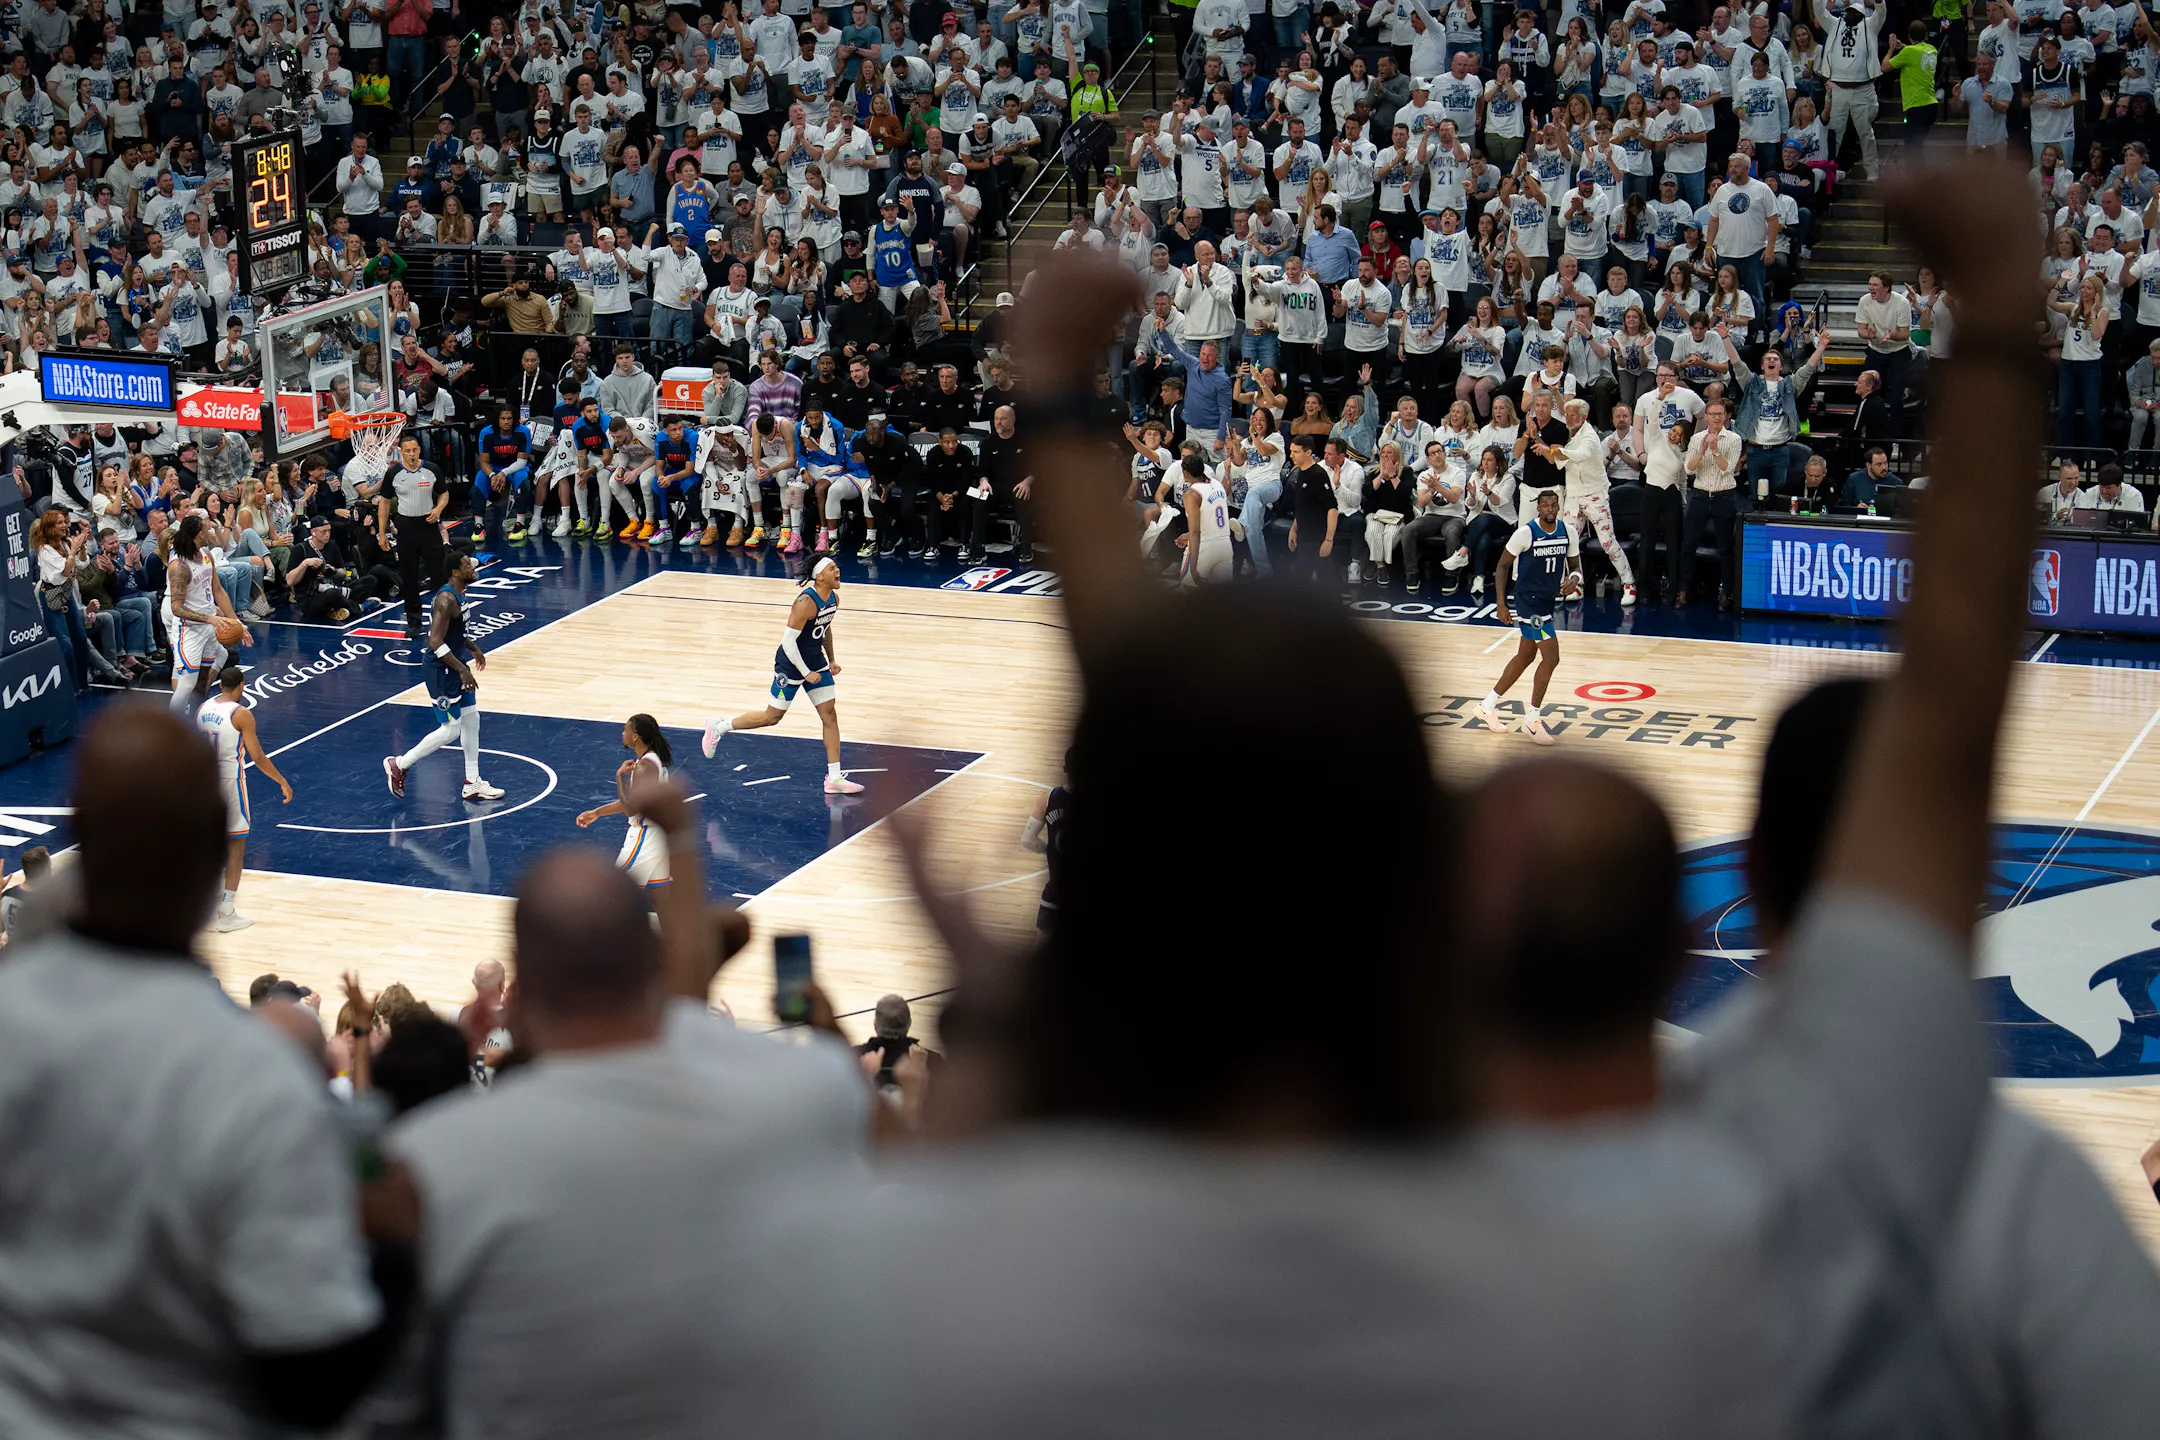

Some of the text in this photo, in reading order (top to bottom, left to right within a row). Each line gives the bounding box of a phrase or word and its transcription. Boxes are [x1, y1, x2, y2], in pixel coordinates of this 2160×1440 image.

[314, 48, 322, 58] 3
[256, 143, 291, 176] 8:48
[1205, 160, 1213, 172] 5
[1438, 171, 1453, 185] 21
[899, 188, 930, 197] MINNESOTA
[251, 173, 291, 229] 24
[678, 199, 704, 209] THUNDER
[688, 210, 695, 221] 2
[266, 231, 302, 251] TISSOT
[884, 251, 901, 268] 10
[717, 304, 744, 317] WOLVES
[2073, 331, 2081, 342] 5
[51, 362, 163, 403] NBAStore.com
[676, 384, 690, 400] G
[203, 402, 260, 422] StateFar
[83, 473, 92, 489] 27
[1142, 482, 1153, 498] 11
[5, 512, 20, 536] GET
[1215, 505, 1225, 529] 8
[8, 533, 24, 556] THE
[1533, 547, 1567, 557] MINNESOTA
[14, 556, 30, 579] App
[1544, 557, 1557, 573] 11
[204, 588, 212, 602] 6
[1348, 600, 1518, 621] oogle
[2031, 599, 2048, 612] NBA
[9, 622, 43, 645] Google
[242, 639, 373, 711] Michelob
[201, 713, 224, 726] WIGGINS
[1440, 694, 1758, 731] TARGET
